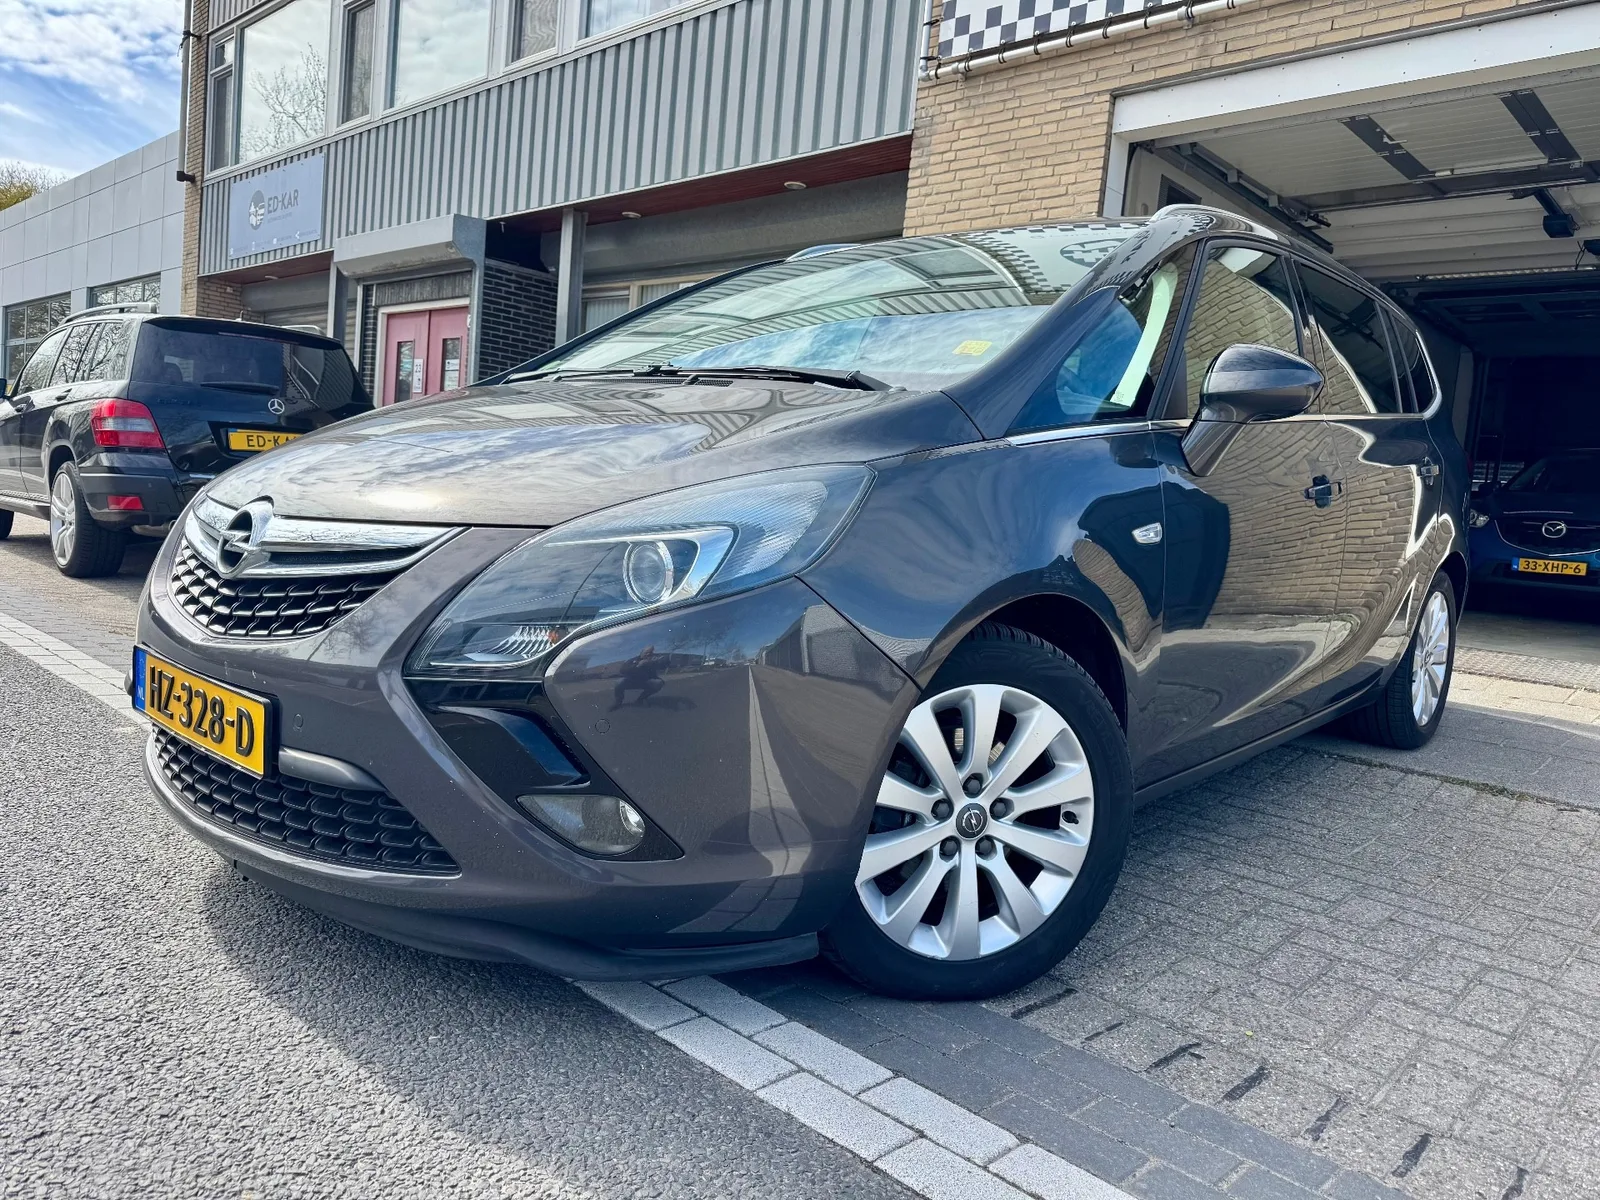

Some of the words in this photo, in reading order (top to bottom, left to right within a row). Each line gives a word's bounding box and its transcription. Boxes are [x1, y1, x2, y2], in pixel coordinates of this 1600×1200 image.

[267, 189, 299, 214] ED-KAR
[246, 435, 297, 447] ED-K
[1523, 560, 1581, 574] 33-XHP-6
[150, 665, 254, 757] HZ-328-D
